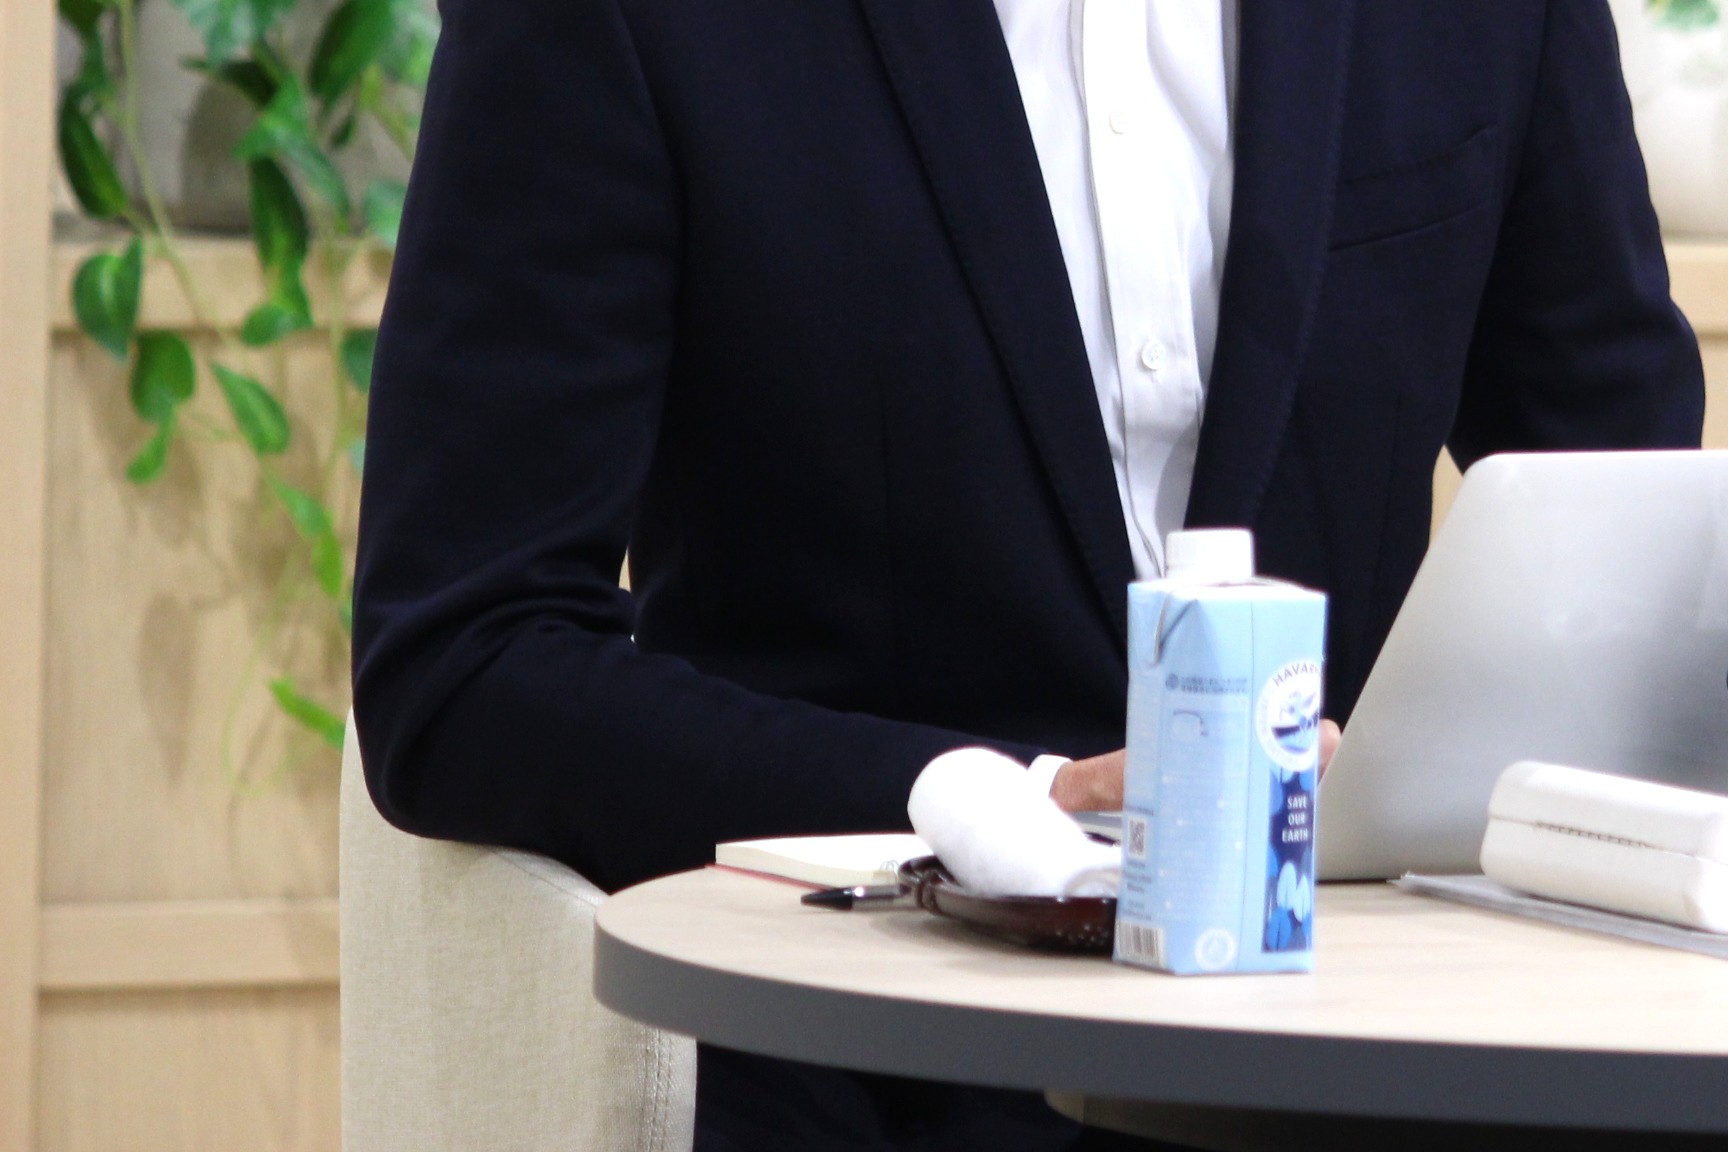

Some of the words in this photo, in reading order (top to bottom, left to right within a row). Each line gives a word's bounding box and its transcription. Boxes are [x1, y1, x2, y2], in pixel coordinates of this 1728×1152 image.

[1287, 795, 1307, 809] SAVE
[1288, 812, 1306, 826] OUR
[1281, 828, 1309, 843] EARTH
